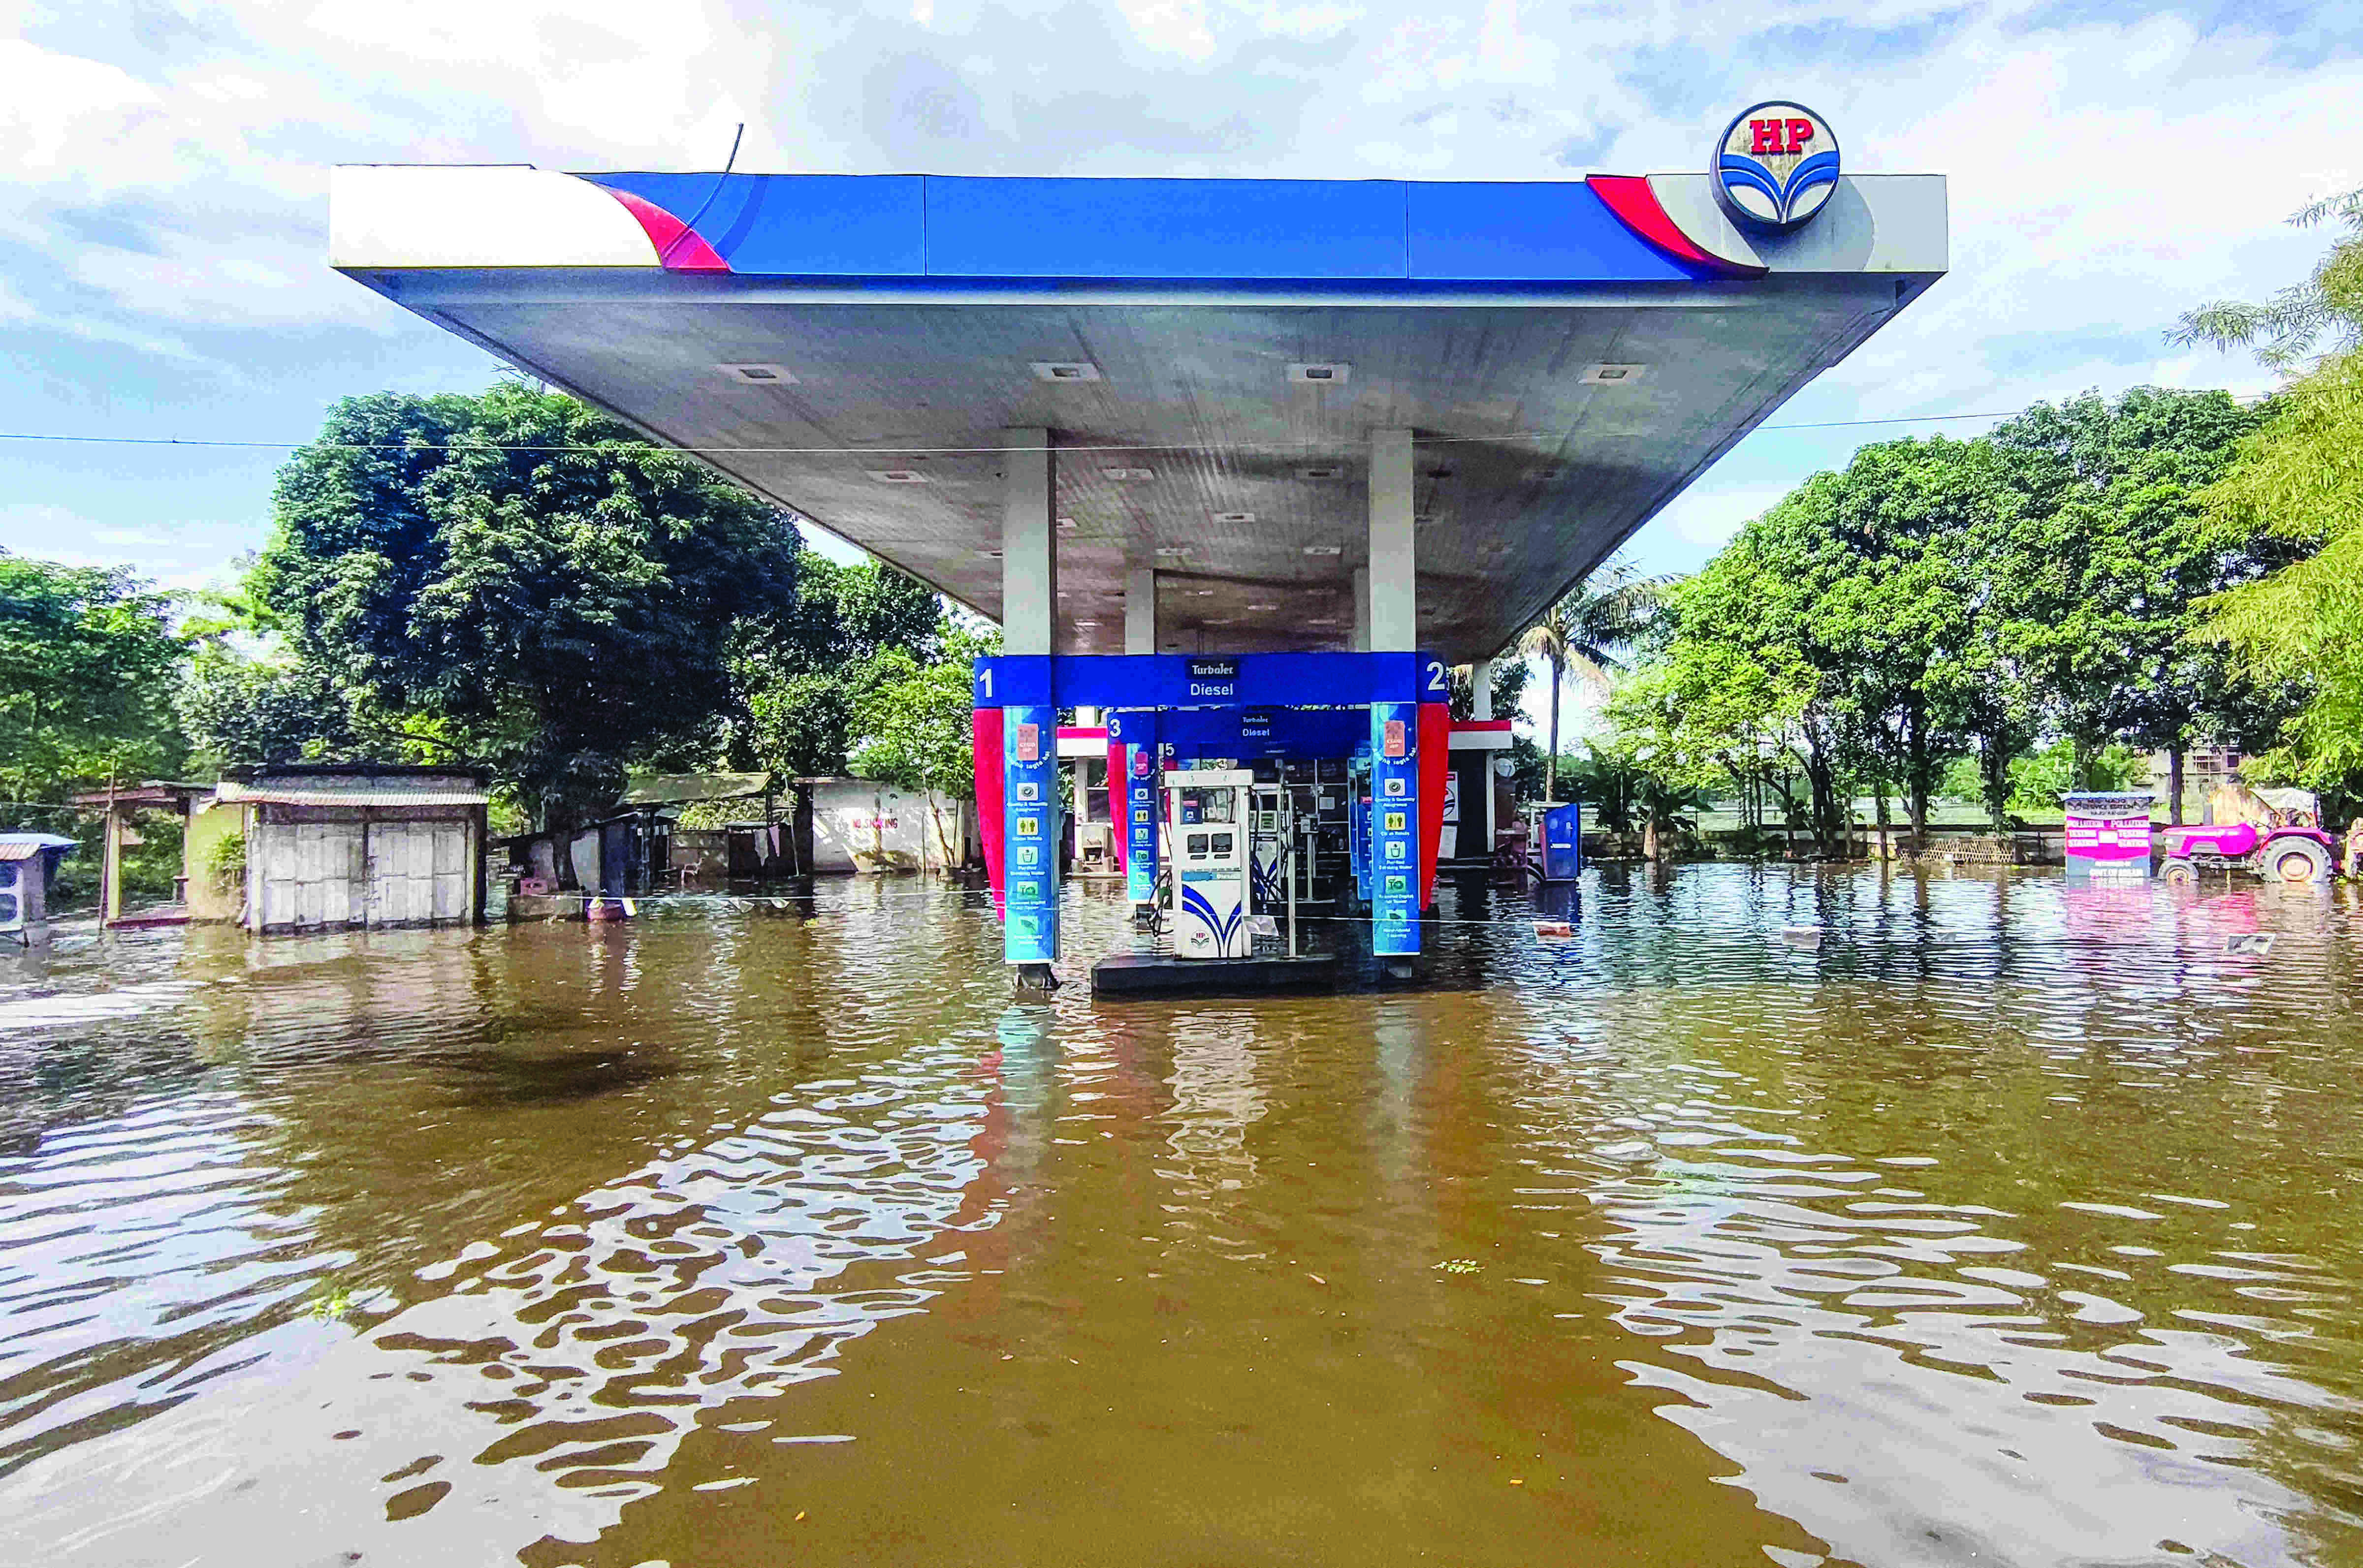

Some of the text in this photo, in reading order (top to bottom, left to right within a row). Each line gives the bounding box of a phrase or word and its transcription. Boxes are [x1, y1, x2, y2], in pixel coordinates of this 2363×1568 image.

[1749, 118, 1814, 155] HP
[979, 668, 992, 697] 1
[1426, 661, 1445, 690] 2
[1190, 683, 1233, 695] Diesel
[1110, 719, 1121, 737] 3
[1242, 728, 1270, 737] Diesel
[1165, 743, 1175, 756] 5
